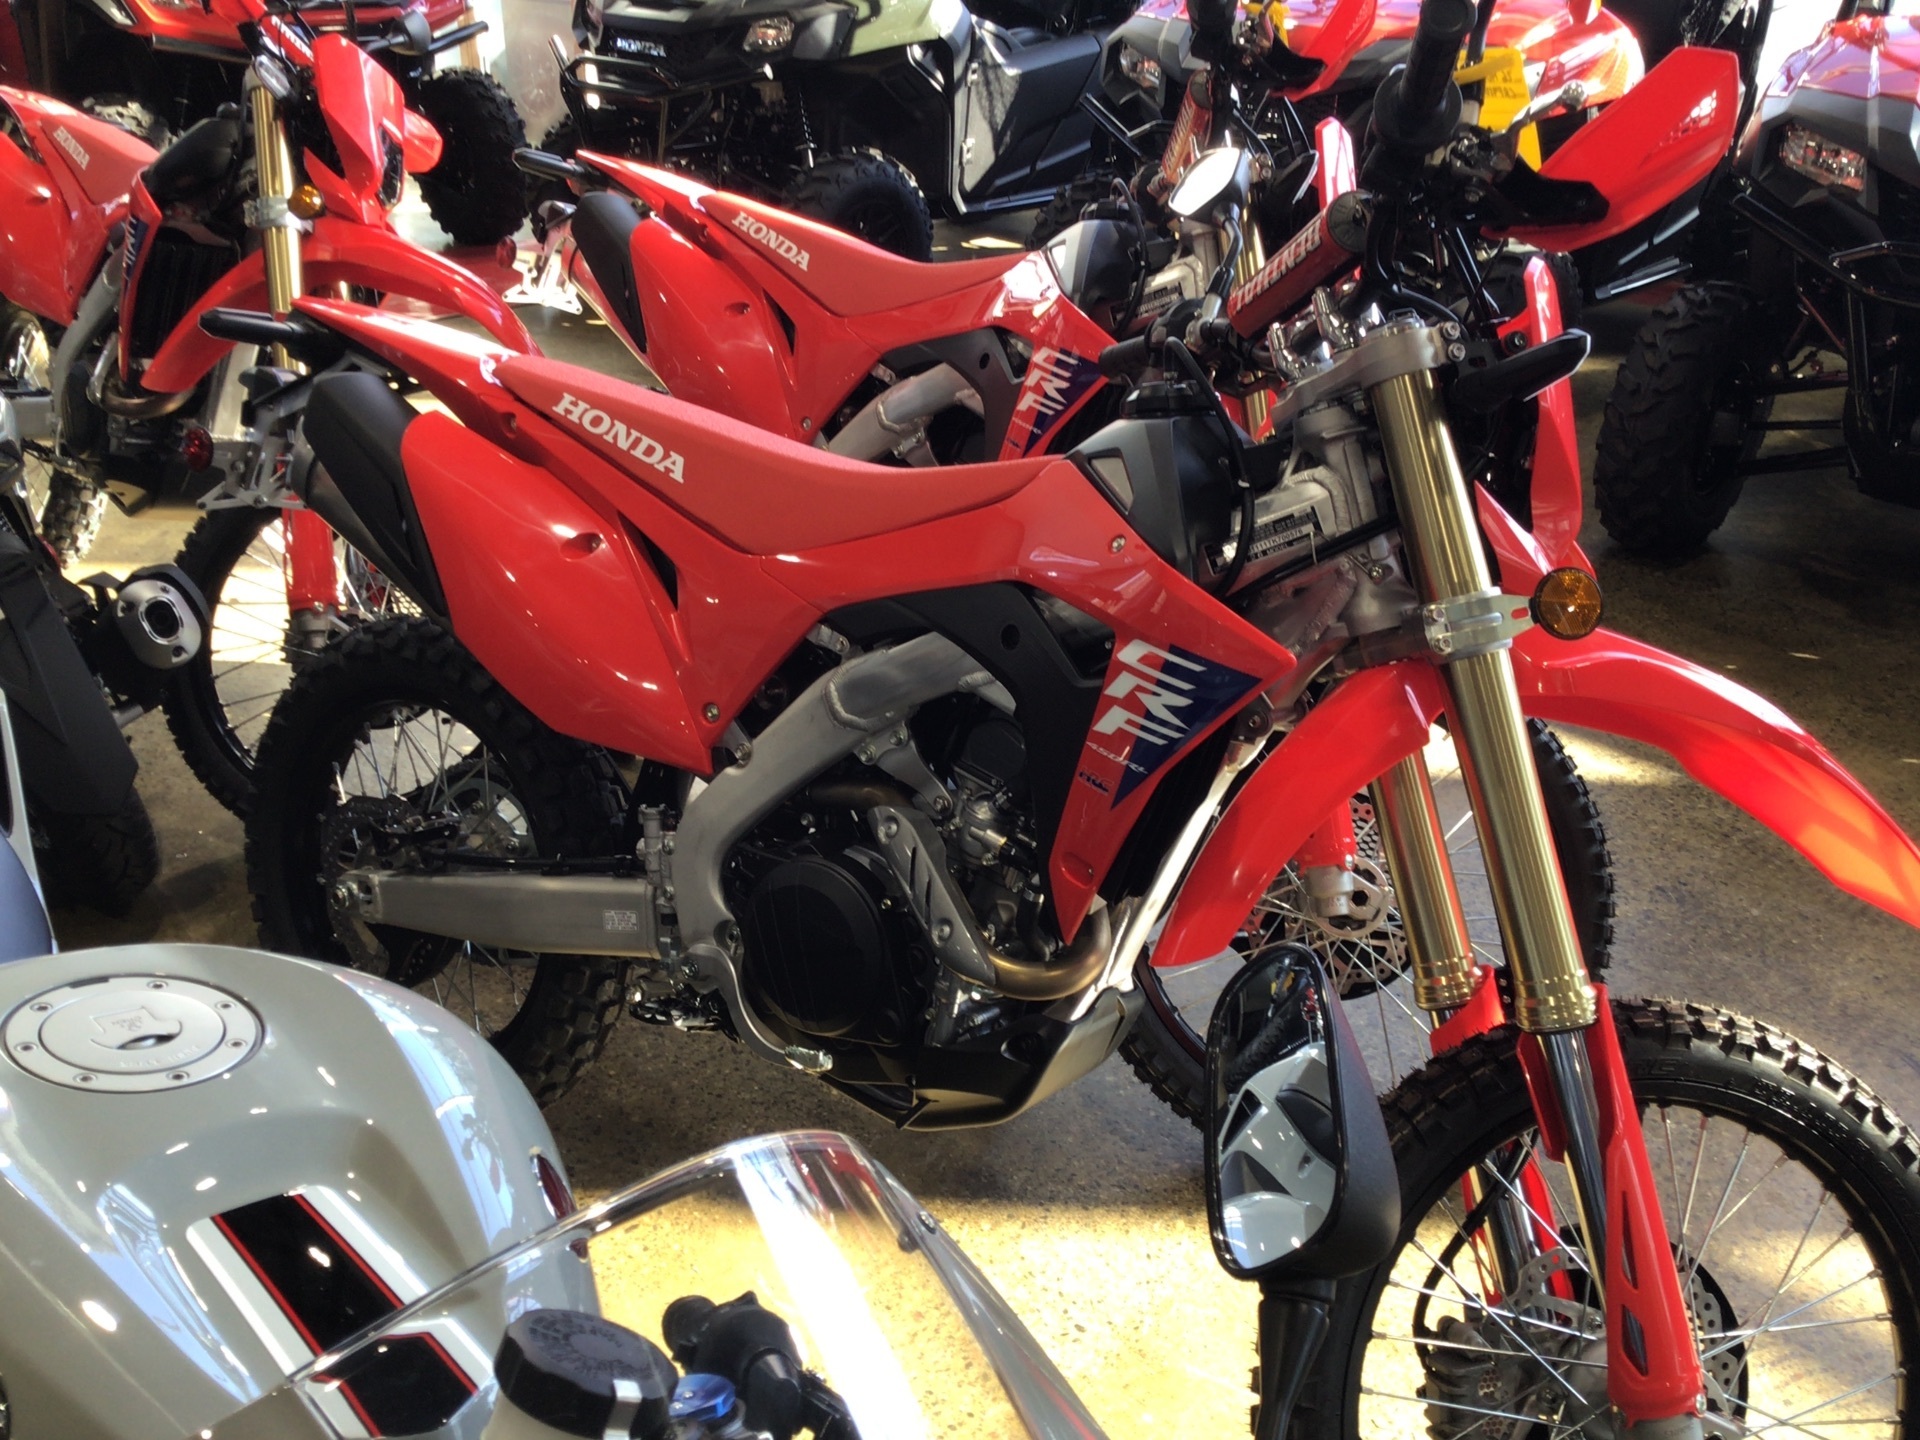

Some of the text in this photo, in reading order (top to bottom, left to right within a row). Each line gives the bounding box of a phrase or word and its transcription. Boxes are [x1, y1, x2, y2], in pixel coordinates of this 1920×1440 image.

[52, 125, 90, 171] HONDA
[731, 210, 810, 272] HONDA
[1235, 217, 1322, 312] RENTHAL
[1016, 346, 1082, 416] CRF
[551, 391, 685, 484] HONDA
[1092, 638, 1208, 746] CRF
